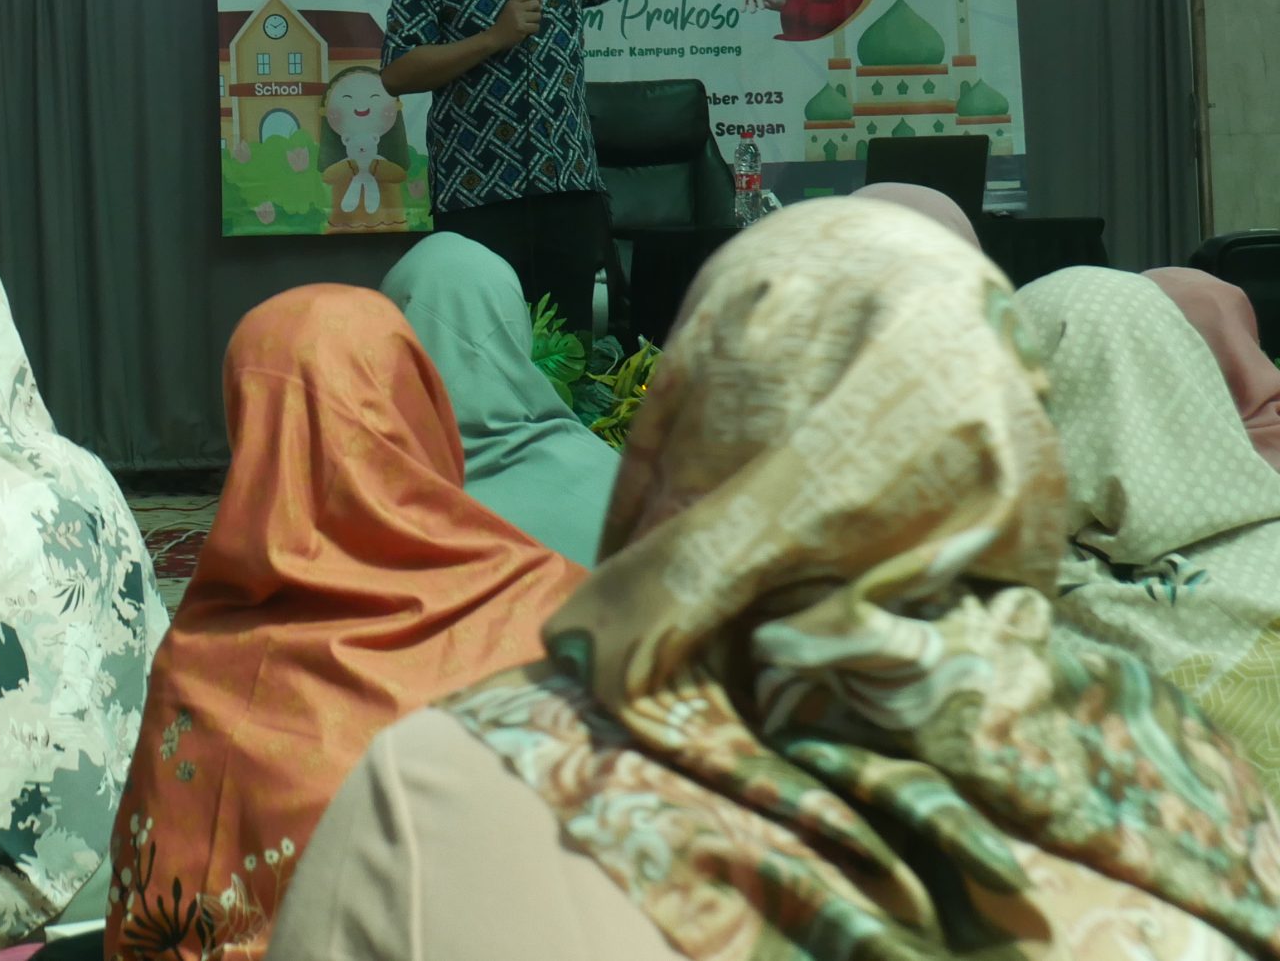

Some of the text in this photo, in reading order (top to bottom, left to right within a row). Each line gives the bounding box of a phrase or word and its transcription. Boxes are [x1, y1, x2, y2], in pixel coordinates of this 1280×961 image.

[584, 45, 742, 58] ounder Kampung Dongeng
[254, 82, 302, 96] School
[744, 91, 784, 104] 2023
[715, 122, 786, 138] Senayan
